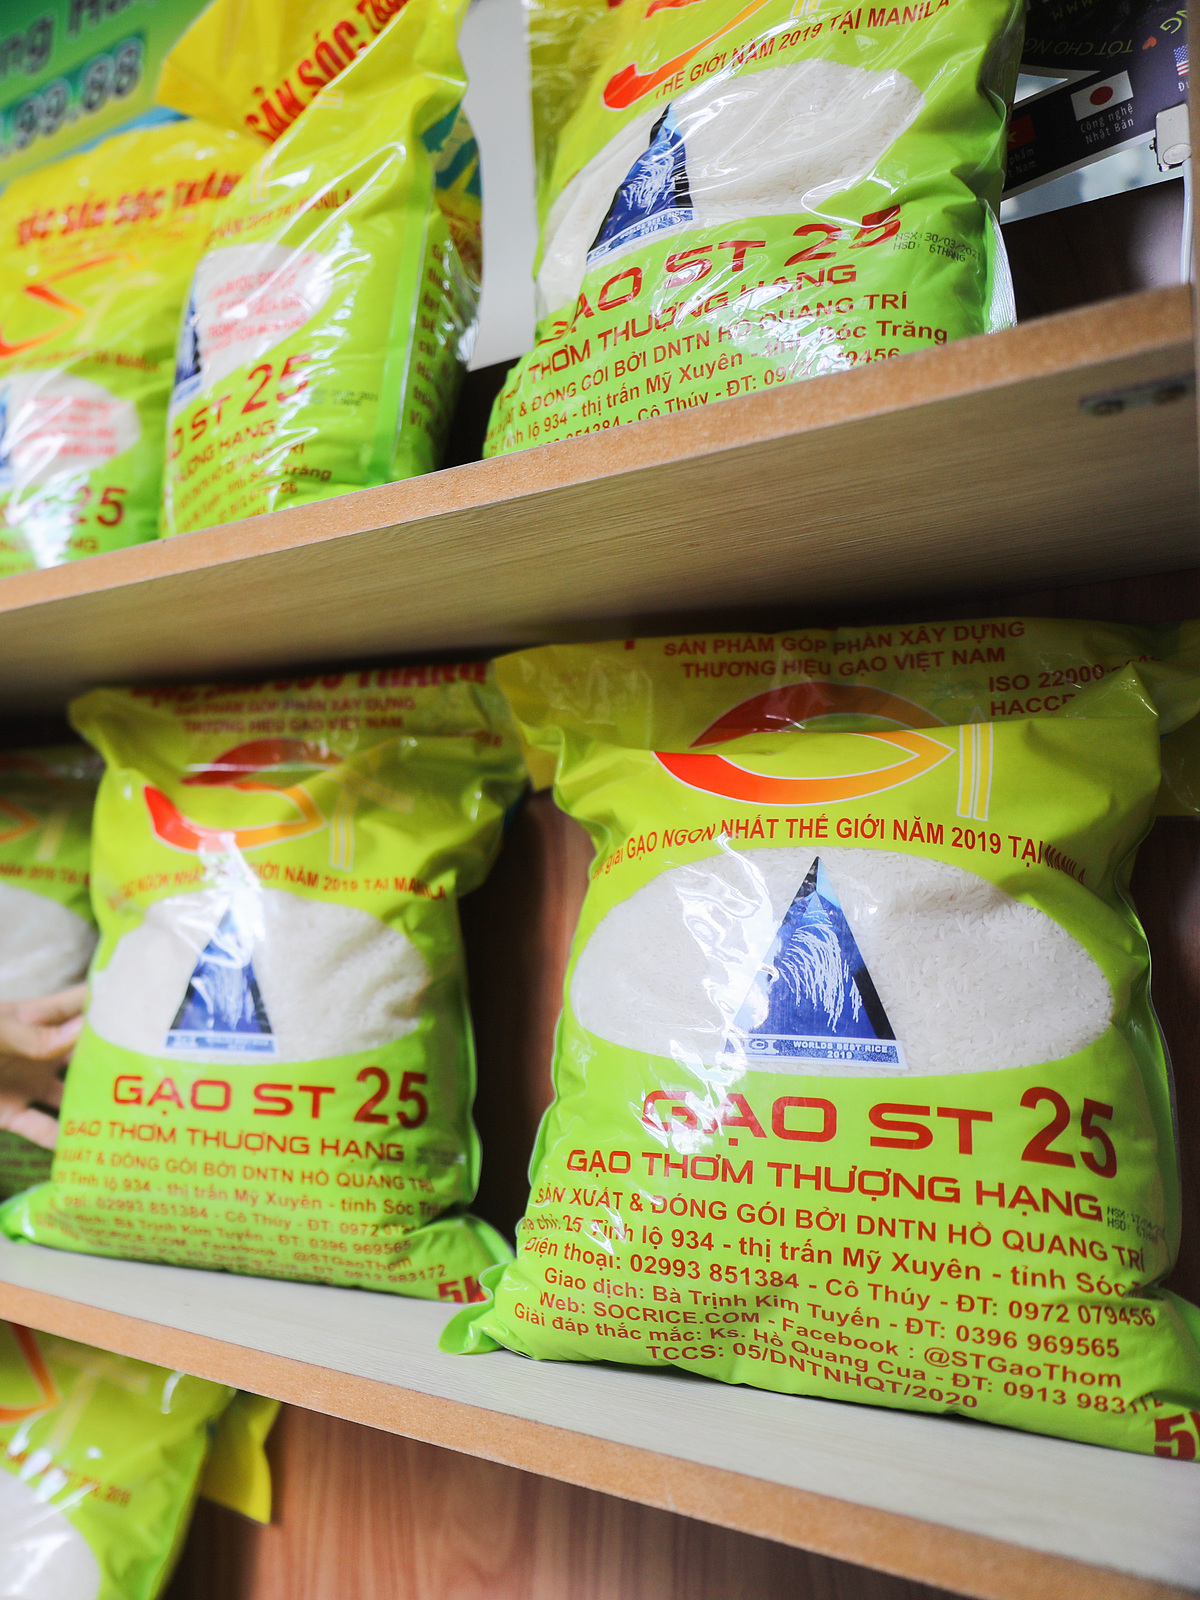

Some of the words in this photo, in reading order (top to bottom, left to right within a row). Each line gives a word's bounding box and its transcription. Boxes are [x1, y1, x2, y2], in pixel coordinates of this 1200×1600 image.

[690, 52, 726, 82] GIỚI
[778, 22, 823, 51] 2019
[830, 8, 862, 35] TẠI
[867, 0, 950, 28] MANILA
[1080, 115, 1104, 133] Công
[1108, 103, 1134, 122] nghệ
[1085, 127, 1111, 145] Nhật
[1016, 160, 1037, 175] Nam
[664, 240, 766, 289] ST
[784, 204, 901, 267] 25
[519, 401, 528, 417] &
[532, 382, 577, 412] ĐÓNG
[582, 365, 610, 391] GÓI
[614, 348, 647, 379] BỞI
[653, 330, 711, 363] DNTN
[864, 291, 907, 311] TRÍ
[528, 421, 540, 441] lộ
[544, 410, 568, 433] 934
[582, 393, 602, 418] thị
[606, 382, 640, 407] trấn
[646, 371, 672, 394] Mỹ
[679, 353, 743, 383] Xuyên
[876, 319, 948, 346] Trăng
[529, 339, 591, 384] THƠM
[726, 374, 757, 398] ĐT:
[191, 394, 233, 442] ST
[241, 354, 312, 414] 25
[664, 638, 708, 657] SẢN
[712, 634, 775, 655] PHẨM
[781, 634, 827, 654] GÓP
[834, 629, 893, 657] PHẦN
[900, 625, 946, 648] XÂY
[954, 620, 1026, 644] DỰNG
[682, 656, 777, 679] THƯƠNG
[783, 657, 832, 679] HIỆU
[839, 655, 888, 678] GẠO
[894, 649, 943, 672] VIỆT
[951, 646, 1006, 667] NAM
[988, 671, 1031, 693] ISO
[627, 831, 658, 861] GẠO
[662, 823, 716, 849] NGON
[720, 814, 779, 839] NHẤT
[786, 813, 829, 839] THẾ
[836, 813, 886, 840] GIỚI
[893, 815, 944, 845] NĂM
[951, 826, 1002, 855] 2019
[1008, 835, 1044, 868] TẠI
[793, 1040, 834, 1051] WORLDS
[864, 1044, 889, 1055] RICE
[826, 1050, 853, 1060] 2019
[113, 1075, 232, 1116] GẠO
[254, 1083, 335, 1119] ST
[354, 1066, 428, 1130] 25
[109, 1121, 176, 1144] THƠM
[187, 1128, 310, 1156] THƯỢNG
[321, 1138, 405, 1163] HẠNG
[642, 1089, 837, 1147] GẠO
[868, 1102, 993, 1155] ST
[1019, 1086, 1118, 1179] 25
[165, 1158, 197, 1175] GÓI
[243, 1165, 294, 1184] DNTN
[336, 1172, 405, 1192] QUANG
[266, 1190, 322, 1211] Xuyên
[384, 1199, 414, 1216] Sóc
[566, 1150, 631, 1178] GẠO
[641, 1152, 753, 1185] THƠM
[767, 1161, 961, 1204] THƯỢNG
[975, 1180, 1104, 1222] HẠNG
[535, 1183, 566, 1204] SẢN
[569, 1187, 623, 1210] XUẤT
[629, 1193, 644, 1213] &
[651, 1193, 728, 1220] ĐÓNG
[736, 1201, 786, 1227] GÓI
[796, 1206, 846, 1233] BỞI
[856, 1214, 937, 1242] DNTN
[948, 1221, 992, 1247] HỒ
[1002, 1229, 1108, 1262] QUANG
[524, 1236, 559, 1259] Điện
[564, 1243, 622, 1272] thoại:
[630, 1253, 701, 1280] 02993
[709, 1262, 800, 1290] 851384
[825, 1276, 860, 1299] Cô
[867, 1281, 931, 1311] Thúy
[956, 1294, 998, 1317] ĐT:
[1008, 1300, 1070, 1324] 0972
[1078, 1303, 1156, 1328] 079456
[537, 1214, 561, 1231] chỉ:
[562, 1215, 584, 1234] 25
[591, 1219, 634, 1244] Tỉnh
[642, 1225, 664, 1250] lộ
[671, 1228, 715, 1251] 934
[739, 1237, 771, 1264] thị
[780, 1238, 833, 1265] trấn
[842, 1247, 882, 1274] Mỹ
[891, 1251, 981, 1282] Xuyên
[1010, 1265, 1067, 1291] tỉnh
[1076, 1273, 1126, 1299] Sóc
[539, 1291, 586, 1316] Web:
[593, 1301, 760, 1326] SOCRICE.COM
[782, 1317, 899, 1357] Facebook
[924, 1347, 1122, 1389] @STGaoThom
[544, 1267, 586, 1291] Giao
[593, 1278, 645, 1303] dịch:
[653, 1284, 682, 1304] Bà
[688, 1289, 748, 1309] Trịnh
[755, 1294, 799, 1314] Kim
[807, 1302, 880, 1332] Tuyến
[905, 1317, 946, 1339] ĐT:
[956, 1325, 1018, 1349] 0396
[1027, 1333, 1120, 1358] 969565
[514, 1302, 546, 1328] Giải
[552, 1314, 590, 1337] đáp
[596, 1319, 642, 1341] thắc
[649, 1324, 702, 1343] mắc:
[710, 1326, 745, 1342] Ks.
[753, 1328, 784, 1348] Hồ
[791, 1341, 868, 1374] Quang
[878, 1360, 926, 1383] Cua
[951, 1373, 993, 1393] ĐT:
[1003, 1381, 1067, 1406] 0913
[646, 1345, 725, 1363] TCCS:
[733, 1343, 978, 1409] 05/DNTNHQT/2020
